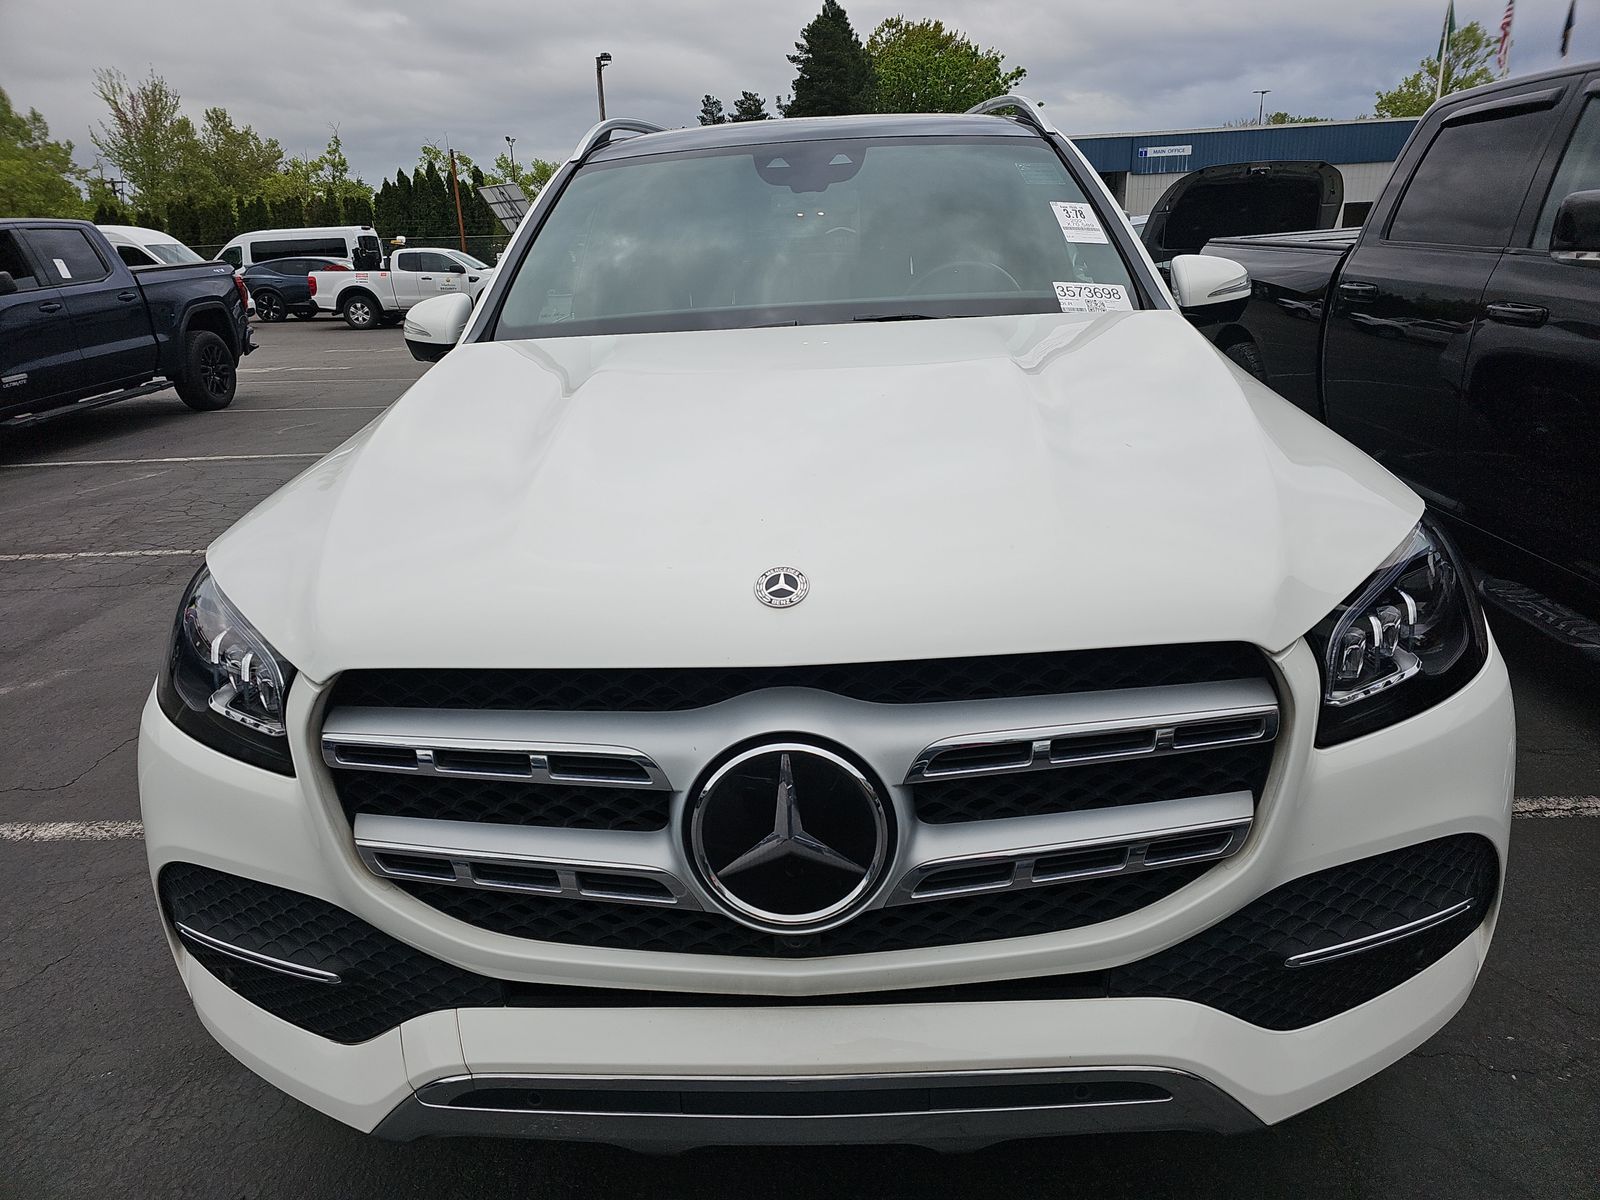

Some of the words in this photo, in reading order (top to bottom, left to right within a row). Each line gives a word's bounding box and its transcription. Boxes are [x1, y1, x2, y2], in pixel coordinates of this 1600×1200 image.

[1056, 285, 1121, 300] 3573698
[2, 379, 27, 388] ULTIMATE
[765, 567, 799, 576] MERCEDES
